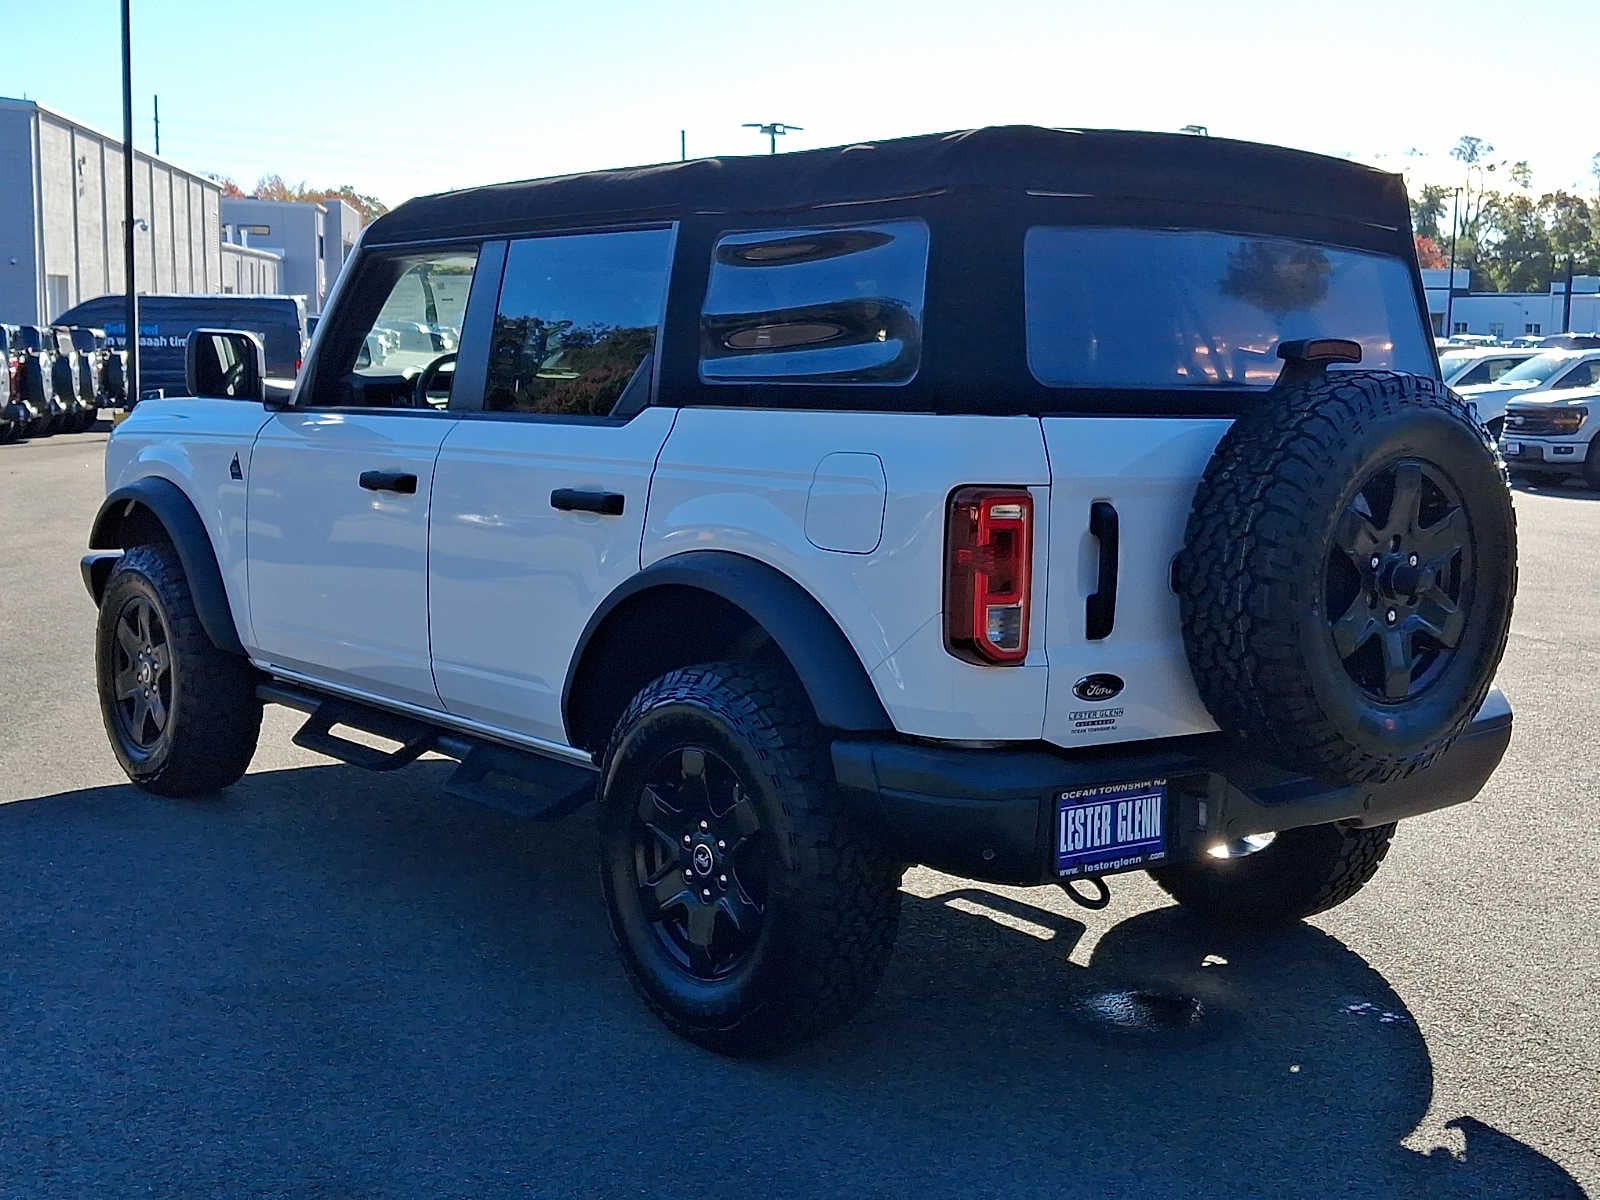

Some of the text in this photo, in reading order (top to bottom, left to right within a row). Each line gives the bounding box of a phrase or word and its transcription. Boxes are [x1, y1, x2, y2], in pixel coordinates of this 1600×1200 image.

[104, 323, 159, 336] Delired
[1068, 708, 1124, 720] LESTER GLENN
[1061, 789, 1096, 800] OCEAN
[1153, 778, 1167, 786] NJ
[1059, 797, 1162, 853] LESTER GLENN
[1084, 856, 1142, 873] lesterglenn
